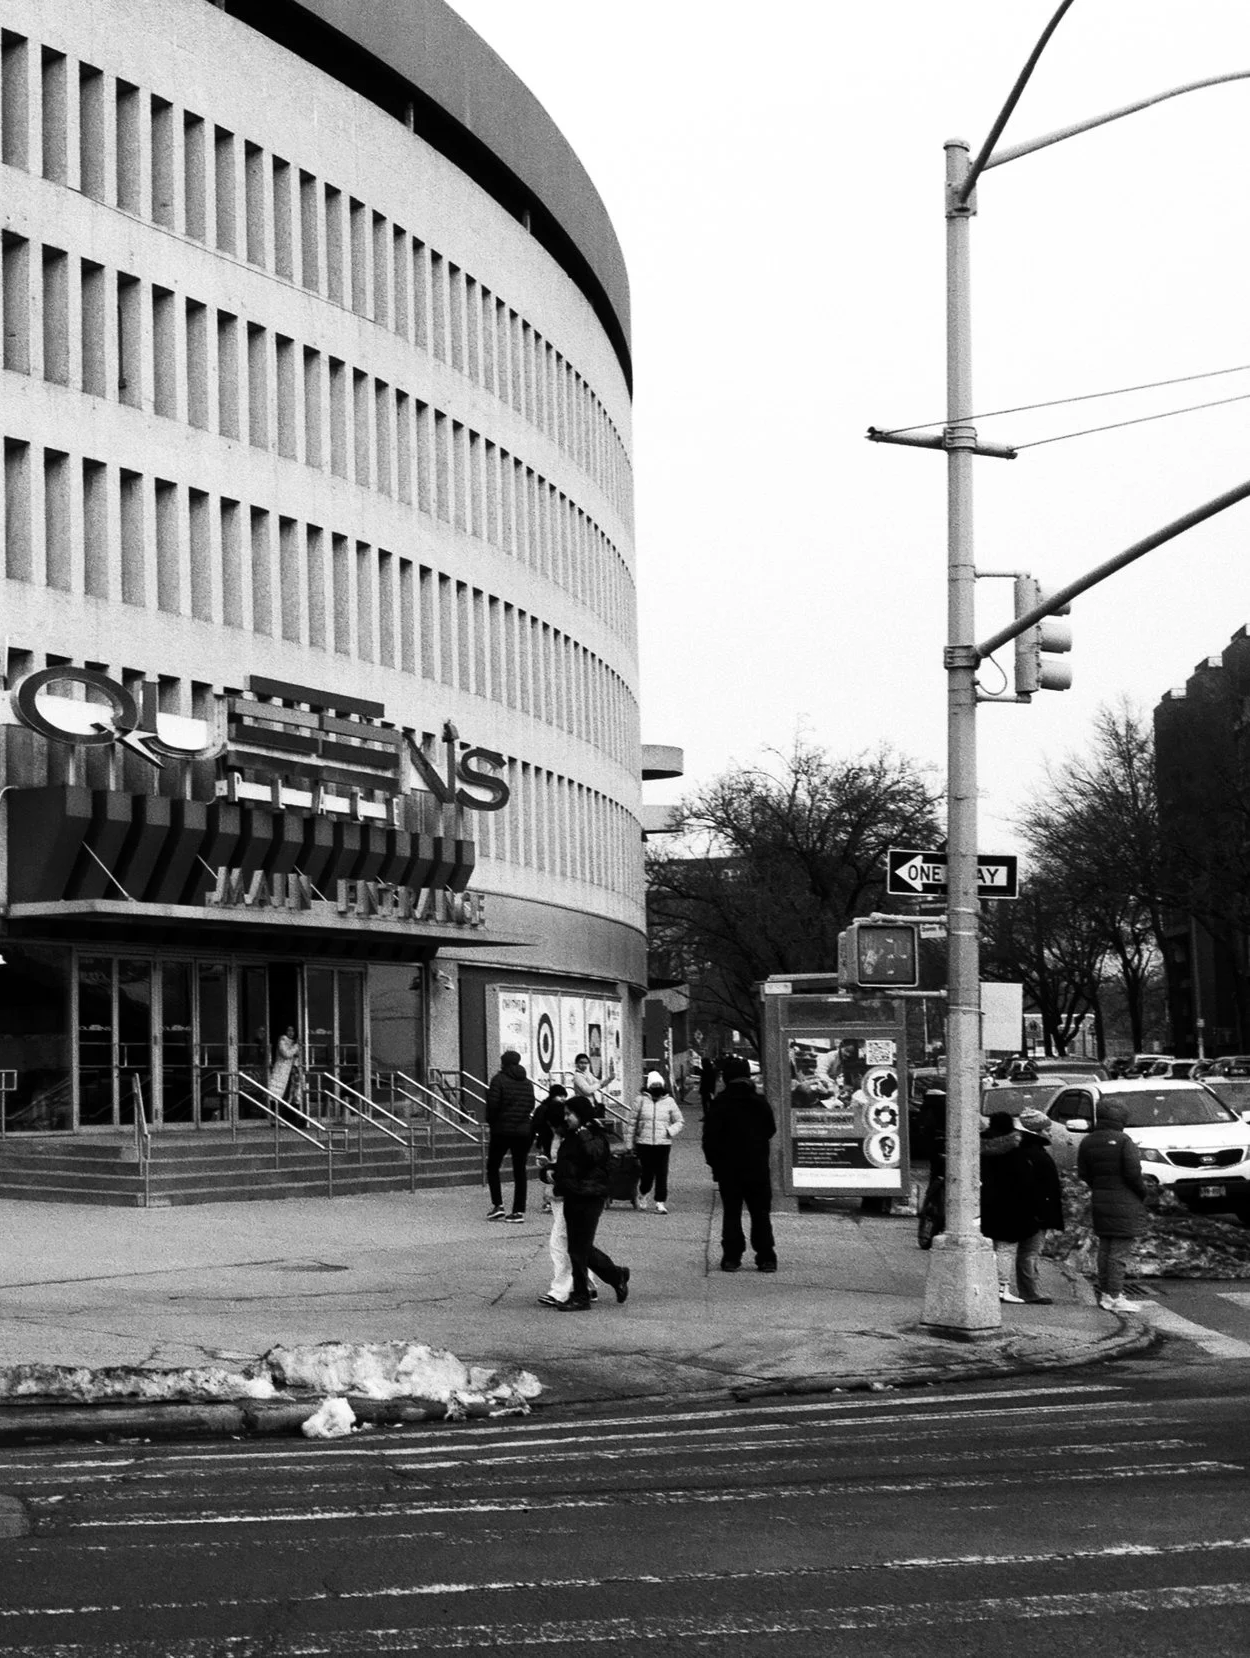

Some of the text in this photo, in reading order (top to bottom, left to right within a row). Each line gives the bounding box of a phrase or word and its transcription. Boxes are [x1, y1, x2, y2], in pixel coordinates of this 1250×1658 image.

[11, 666, 510, 812] QUEENS
[205, 866, 486, 928] MAIN ENTRANCE
[908, 865, 999, 884] ONE AY
